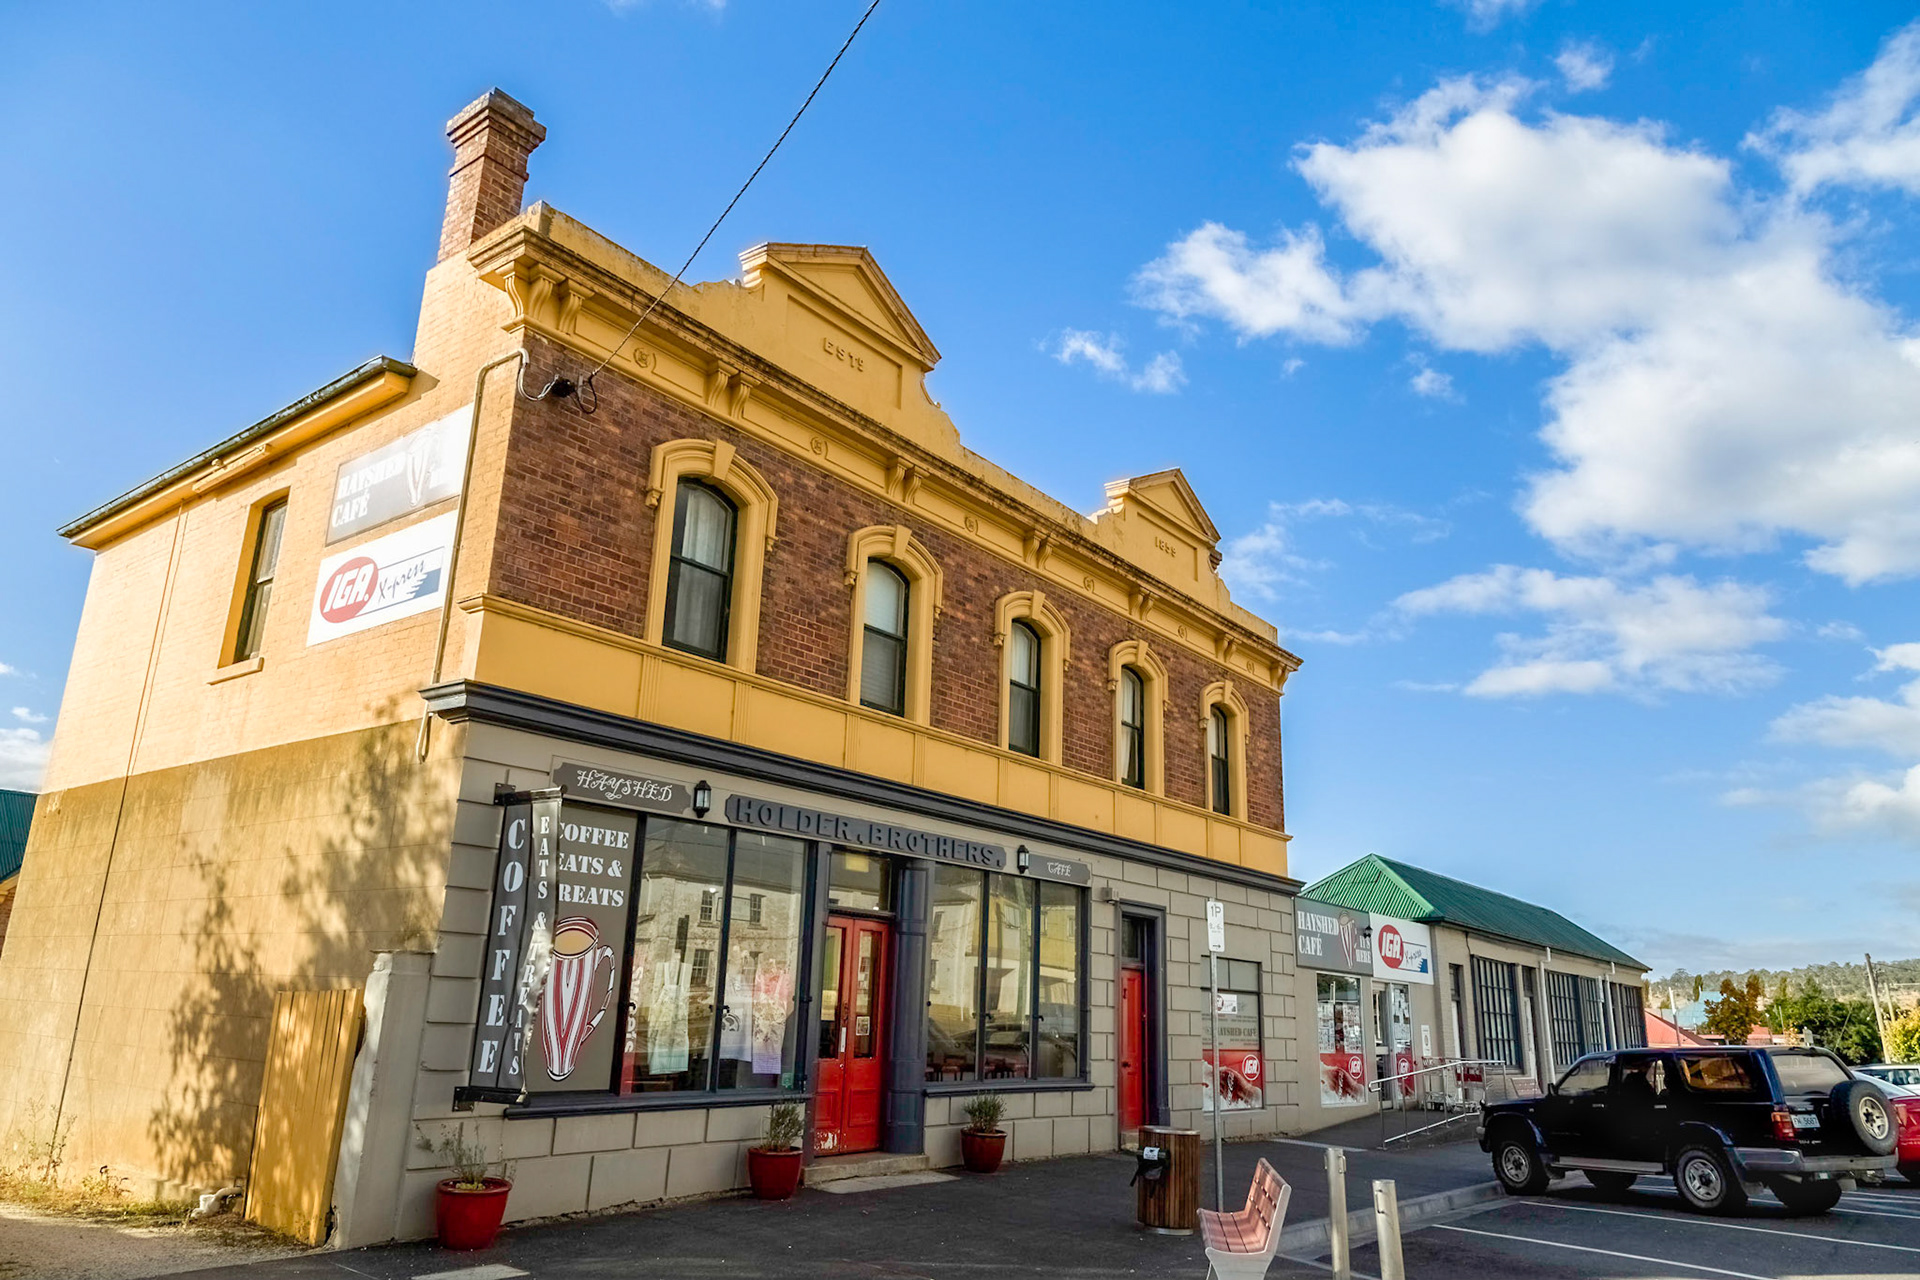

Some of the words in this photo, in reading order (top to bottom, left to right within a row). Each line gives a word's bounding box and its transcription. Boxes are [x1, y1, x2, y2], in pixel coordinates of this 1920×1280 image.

[576, 769, 673, 802] HAYSHED
[538, 816, 550, 899] EATS
[607, 860, 622, 877] &
[1297, 911, 1339, 936] HAYSHED
[478, 819, 525, 1073] COFFEE
[1298, 934, 1322, 956] CAFÉ
[509, 943, 541, 1075] TREATS
